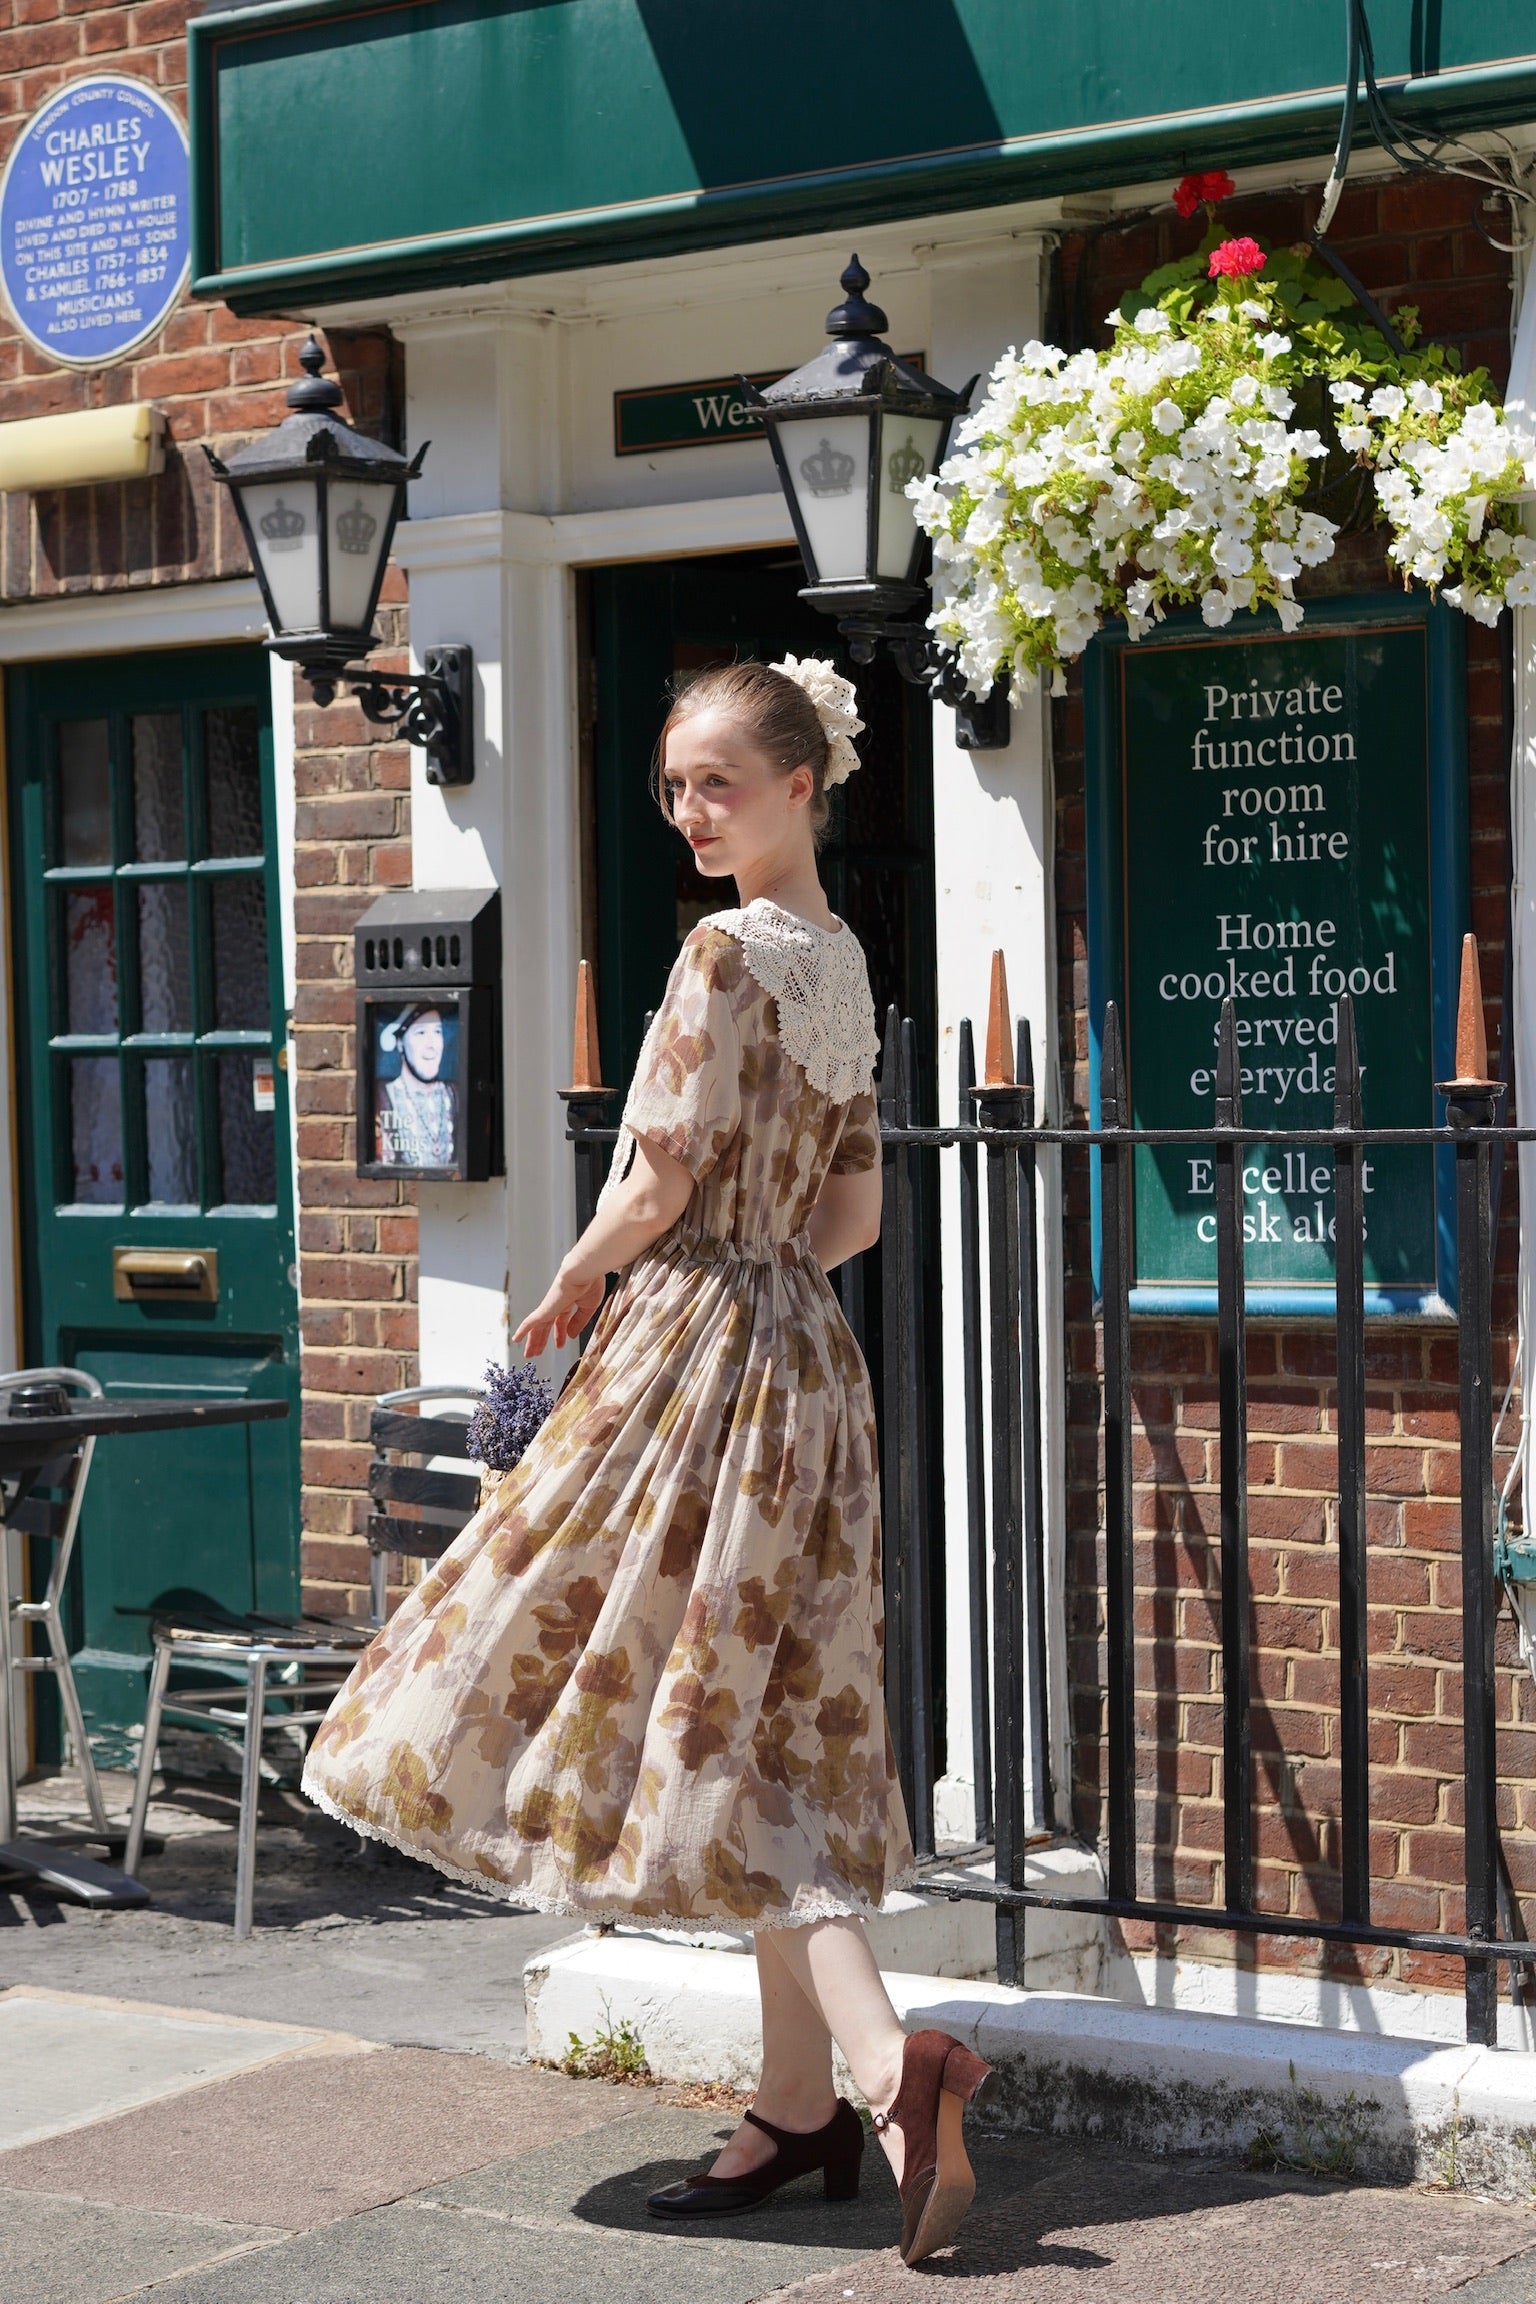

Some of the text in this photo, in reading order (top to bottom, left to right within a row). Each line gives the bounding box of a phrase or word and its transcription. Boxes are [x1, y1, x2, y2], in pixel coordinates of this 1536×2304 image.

[32, 88, 156, 141] LONDON COUNTY COUNCIL
[45, 117, 142, 156] CHARLES
[40, 141, 150, 187] WESLEY
[15, 194, 177, 233] DIVINE AND HYMN WRITER
[15, 212, 177, 249] LIVED AND DIED IN A HOUSE
[15, 228, 177, 266] ON THIS SITE AND HIS SONS
[25, 258, 90, 283] CHARLES
[26, 286, 37, 302] &
[40, 277, 91, 300] SAMUEL
[47, 308, 143, 334] ALSO LIVED HERE
[56, 290, 135, 316] MUSICIANS
[692, 394, 757, 429] We
[1203, 678, 1343, 722] Private
[1190, 723, 1357, 771] function
[1222, 782, 1326, 817] room
[1202, 820, 1349, 866] for hire
[1216, 913, 1336, 951] Home
[1159, 952, 1398, 1001] cooked food
[1190, 1051, 1367, 1105] eeryda
[380, 1110, 413, 1130] The
[381, 1132, 428, 1158] Kings
[1187, 1152, 1375, 1195] Ecellet
[1197, 1200, 1283, 1244] csk
